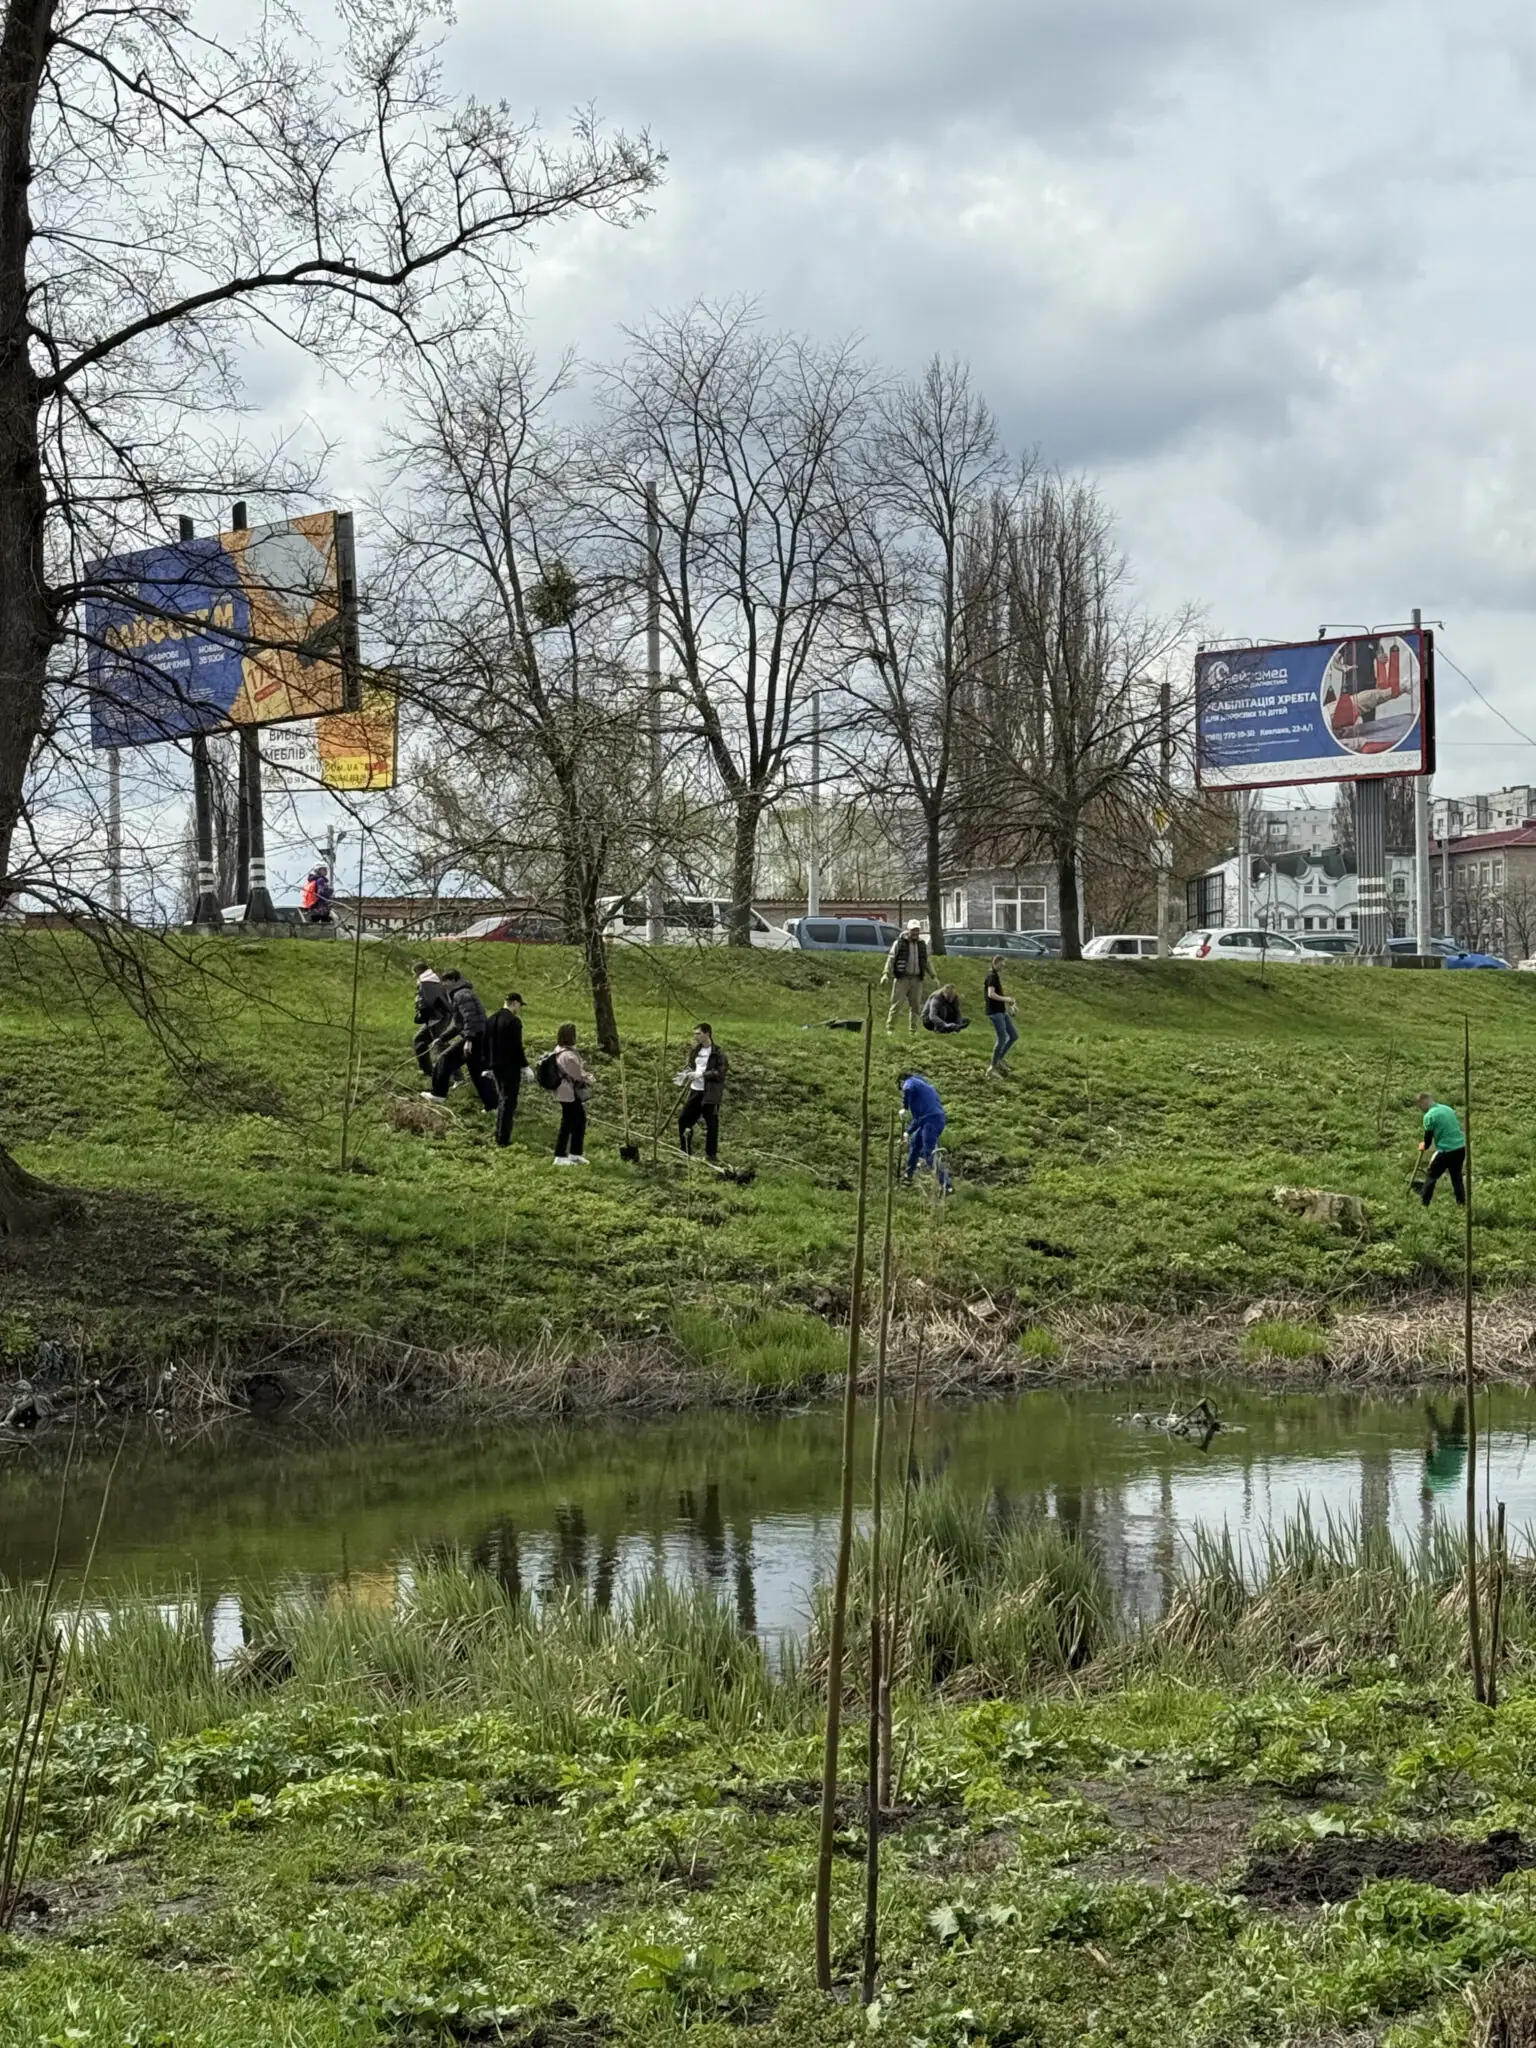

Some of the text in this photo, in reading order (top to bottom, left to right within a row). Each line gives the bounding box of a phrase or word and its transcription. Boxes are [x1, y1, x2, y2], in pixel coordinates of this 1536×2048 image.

[198, 638, 236, 654] МОБІЛЬЙ
[1278, 691, 1318, 704] ХРЕБТА
[1259, 709, 1267, 717] ТА
[1268, 706, 1288, 717] ДІТЕЙ
[263, 747, 306, 760] МЕБЛІВ
